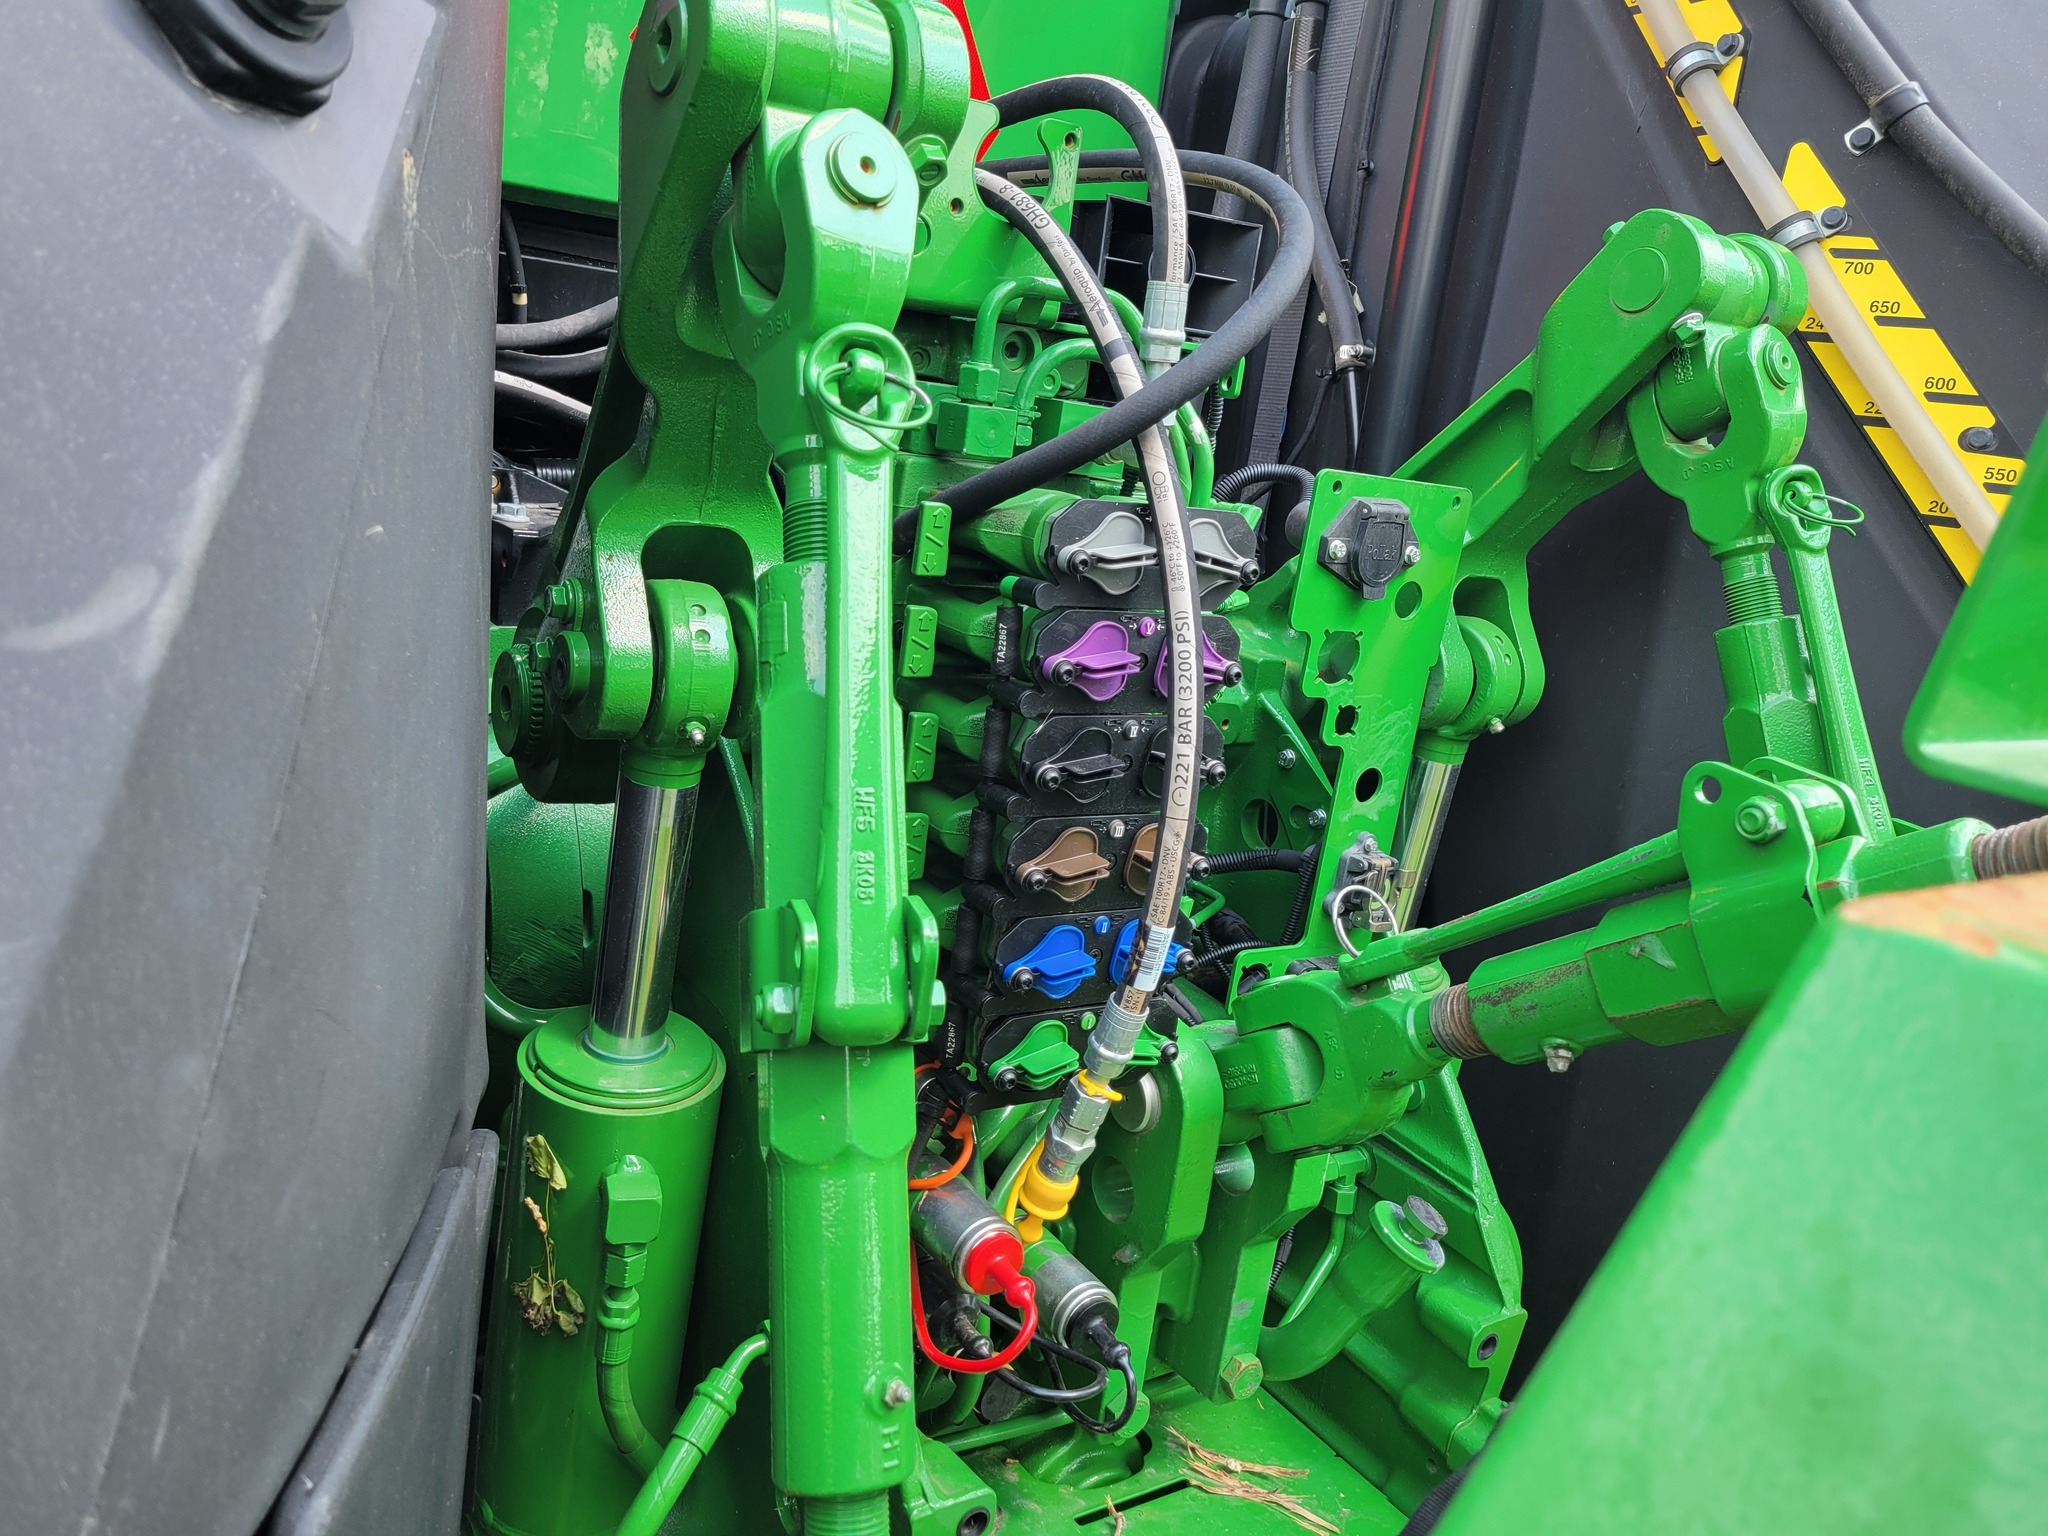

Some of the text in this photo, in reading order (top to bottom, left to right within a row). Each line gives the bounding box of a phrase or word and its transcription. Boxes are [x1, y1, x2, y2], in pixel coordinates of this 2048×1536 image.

[1166, 160, 1175, 177] DNV
[999, 184, 1051, 230] GH681-8
[1843, 261, 1874, 275] 700
[1072, 268, 1102, 313] Aeroquip
[1869, 301, 1900, 314] 650
[1924, 377, 1957, 391] 600
[1984, 467, 2017, 482] 550
[1168, 552, 1175, 563] to
[1175, 552, 1182, 562] to
[1146, 622, 1154, 635] V
[996, 622, 1008, 664] TA22867
[1174, 610, 1192, 786] 221 BAR (3200 PSI)
[1129, 725, 1139, 738] IV
[1114, 825, 1123, 838] III
[1150, 902, 1160, 918] SAE
[1155, 871, 1167, 902] 100R17
[1161, 845, 1171, 865] DNV
[1157, 891, 1170, 926] IC-84/19
[1166, 868, 1176, 886] ABS
[1125, 989, 1135, 1006] 857
[945, 1021, 957, 1059] TA22867
